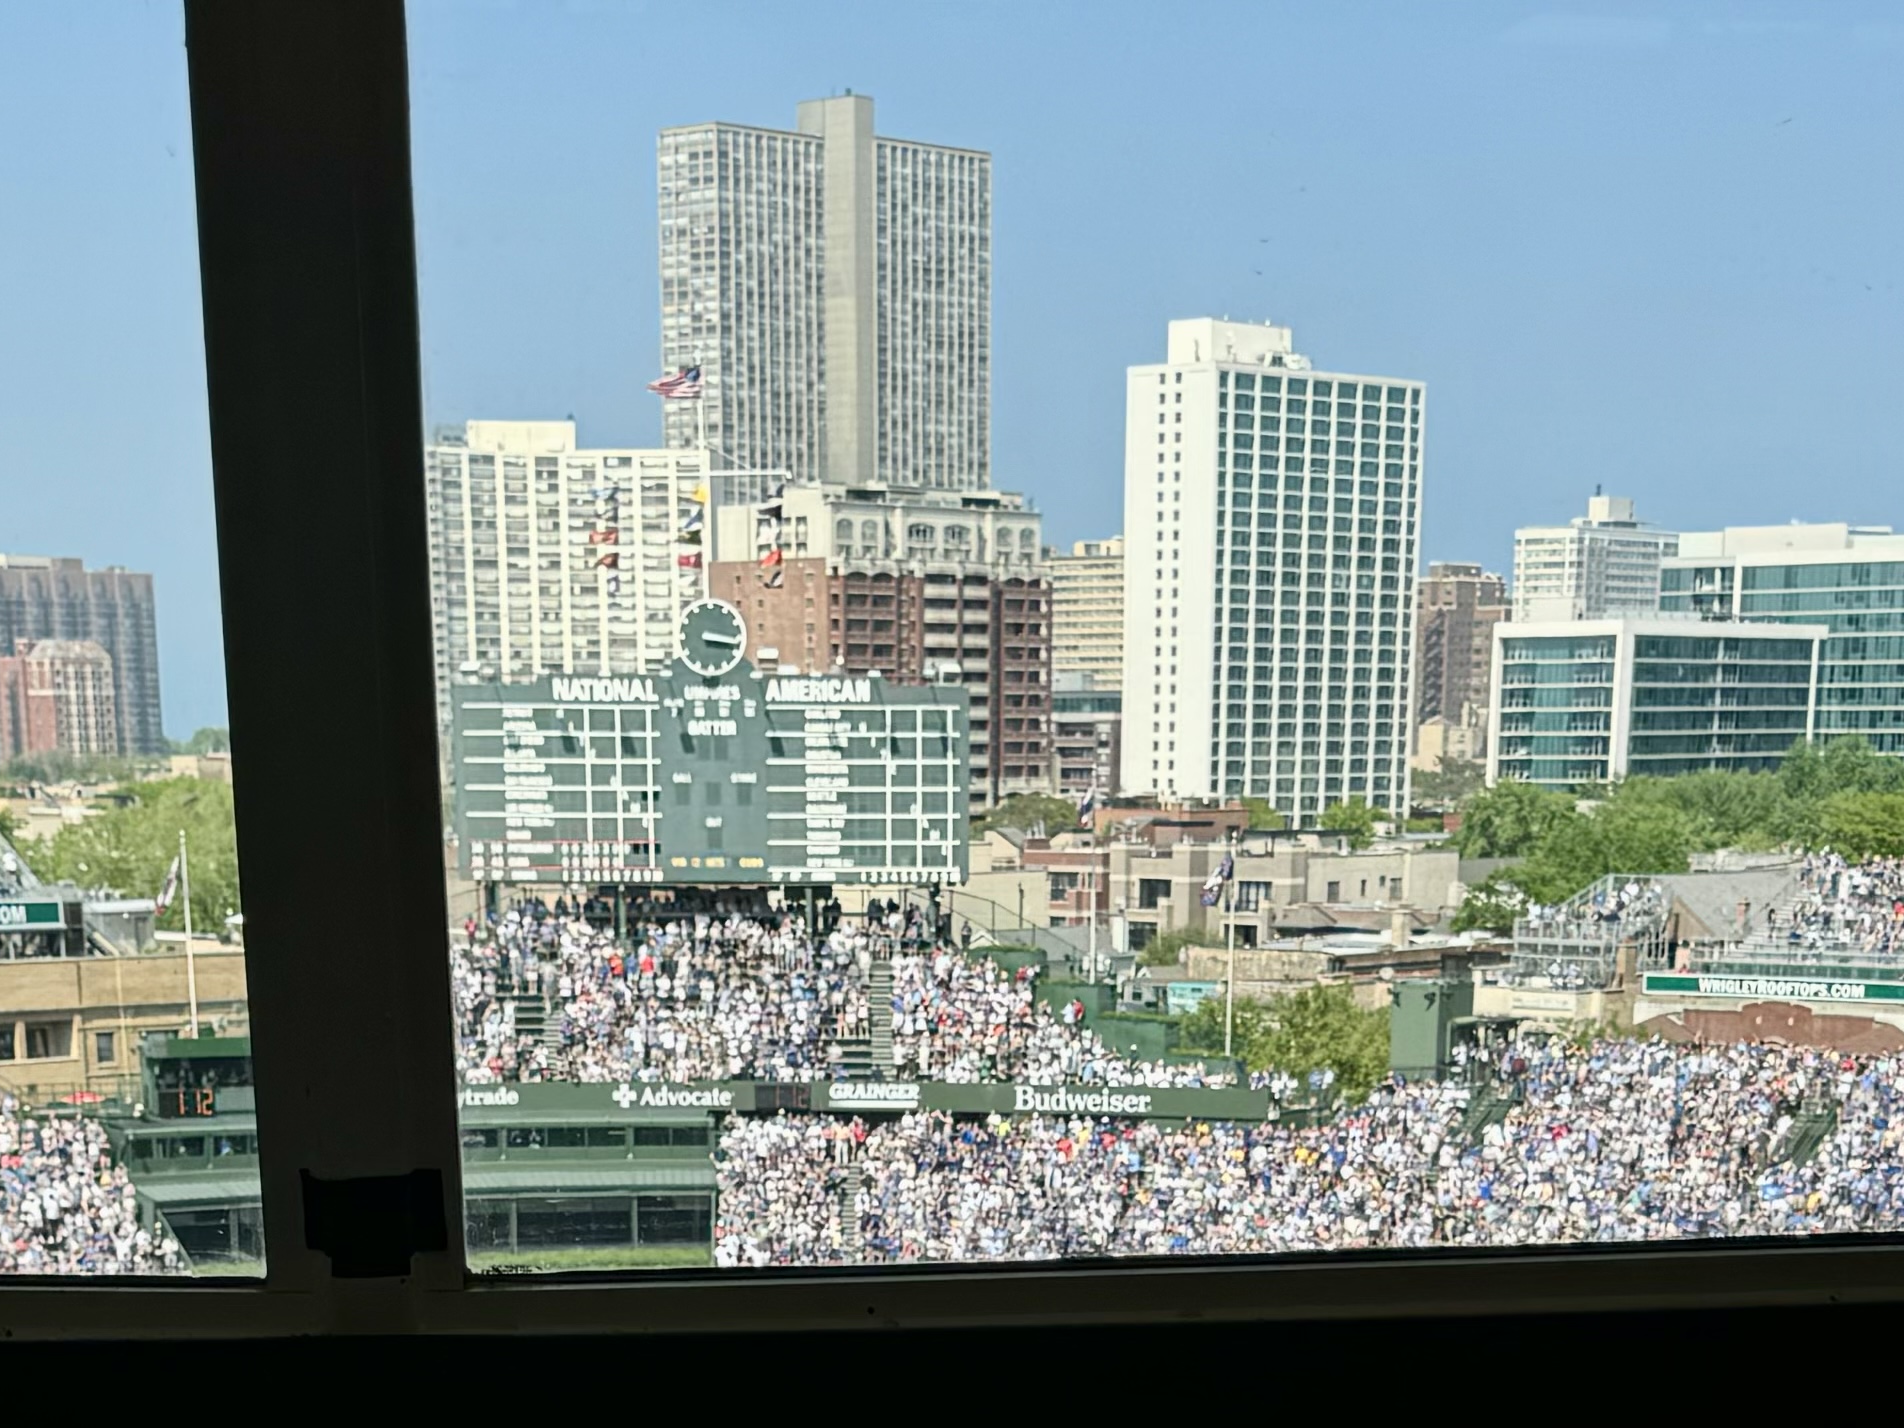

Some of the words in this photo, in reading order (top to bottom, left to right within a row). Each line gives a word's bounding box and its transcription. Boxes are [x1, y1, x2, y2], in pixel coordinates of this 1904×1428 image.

[552, 678, 659, 701] NATIONAL
[765, 678, 871, 702] AMERICAN
[1698, 977, 1866, 999] WRIGLEYROOFTOPS.COM
[640, 1086, 733, 1107] Advocate
[829, 1083, 920, 1101] GRAINGER
[1014, 1085, 1152, 1112] Budweiser
